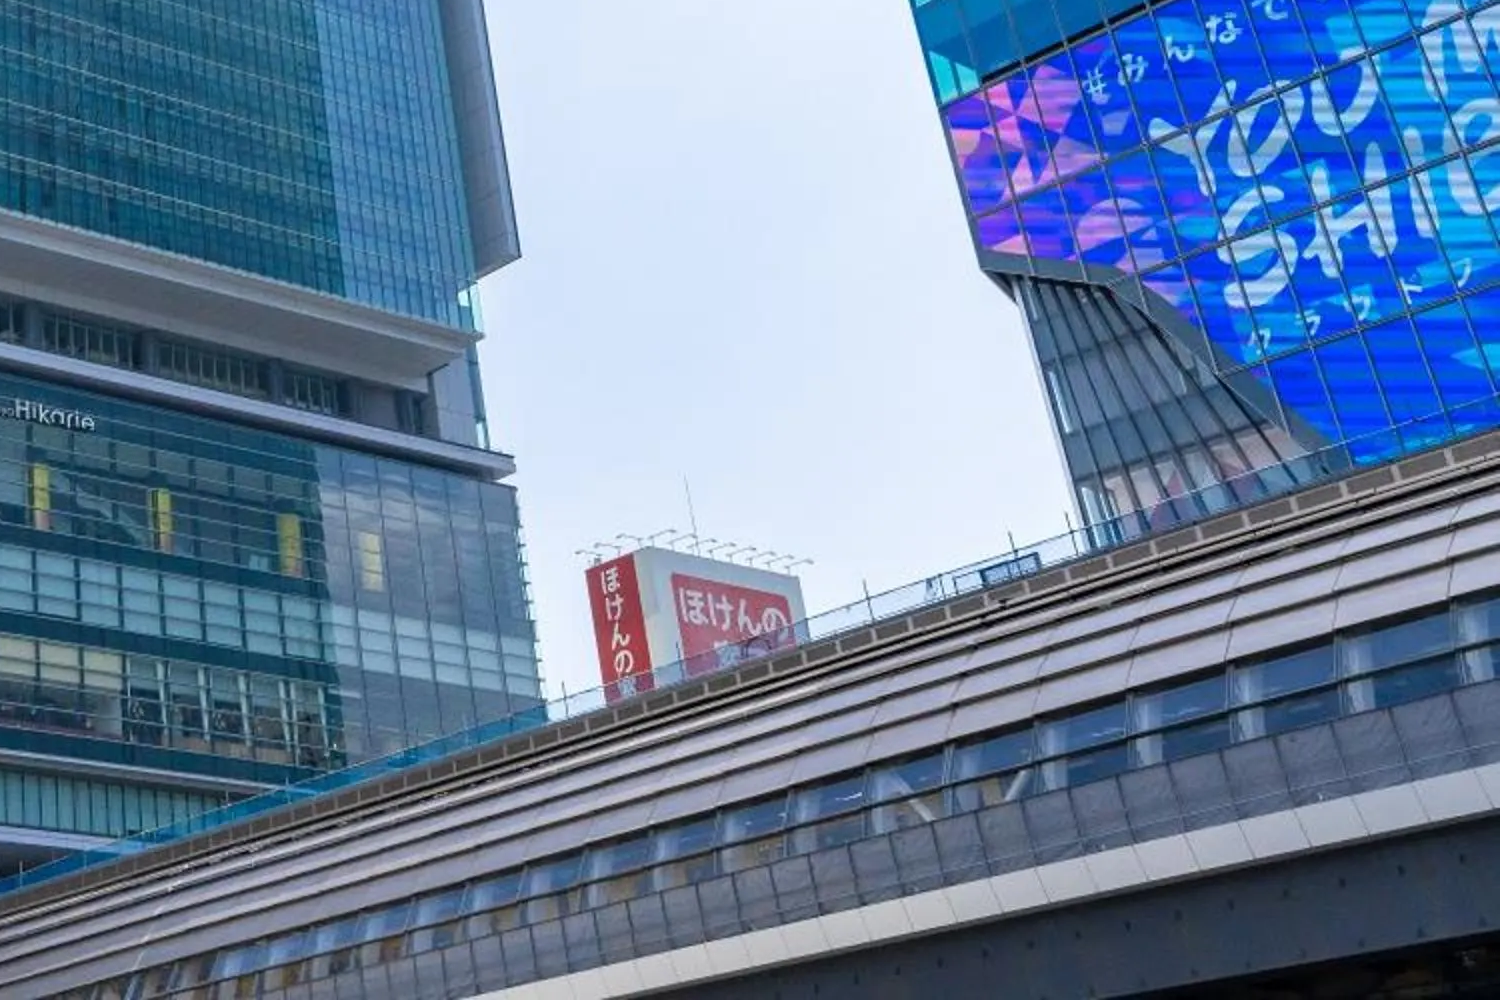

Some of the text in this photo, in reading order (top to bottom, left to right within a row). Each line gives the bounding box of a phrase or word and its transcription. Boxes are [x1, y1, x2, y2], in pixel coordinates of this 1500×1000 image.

[1149, 45, 1381, 197] YOU
[15, 398, 95, 431] Hikarie
[679, 587, 789, 637] ほけんの
